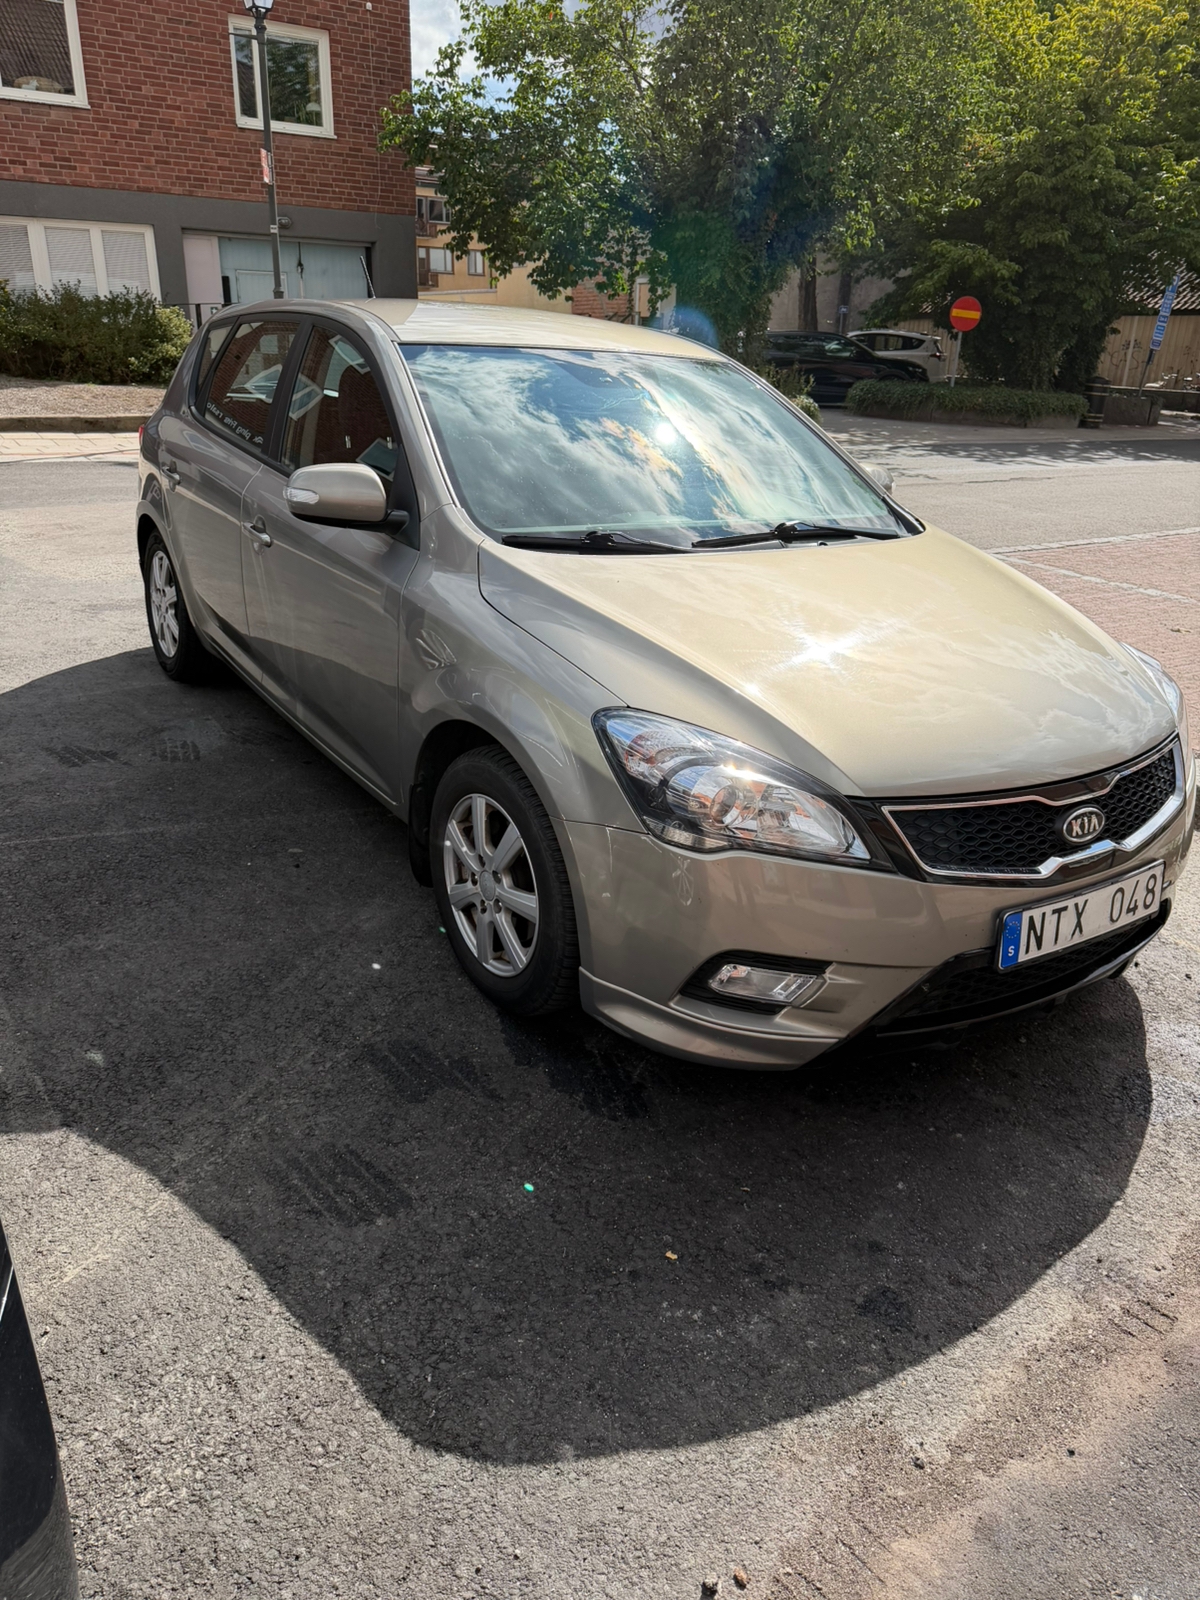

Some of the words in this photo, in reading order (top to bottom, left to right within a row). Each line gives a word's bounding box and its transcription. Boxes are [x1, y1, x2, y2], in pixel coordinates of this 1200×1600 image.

[1071, 815, 1099, 837] KIA
[1025, 899, 1088, 954] NTX
[1110, 874, 1157, 923] 048
[1007, 945, 1015, 957] S
